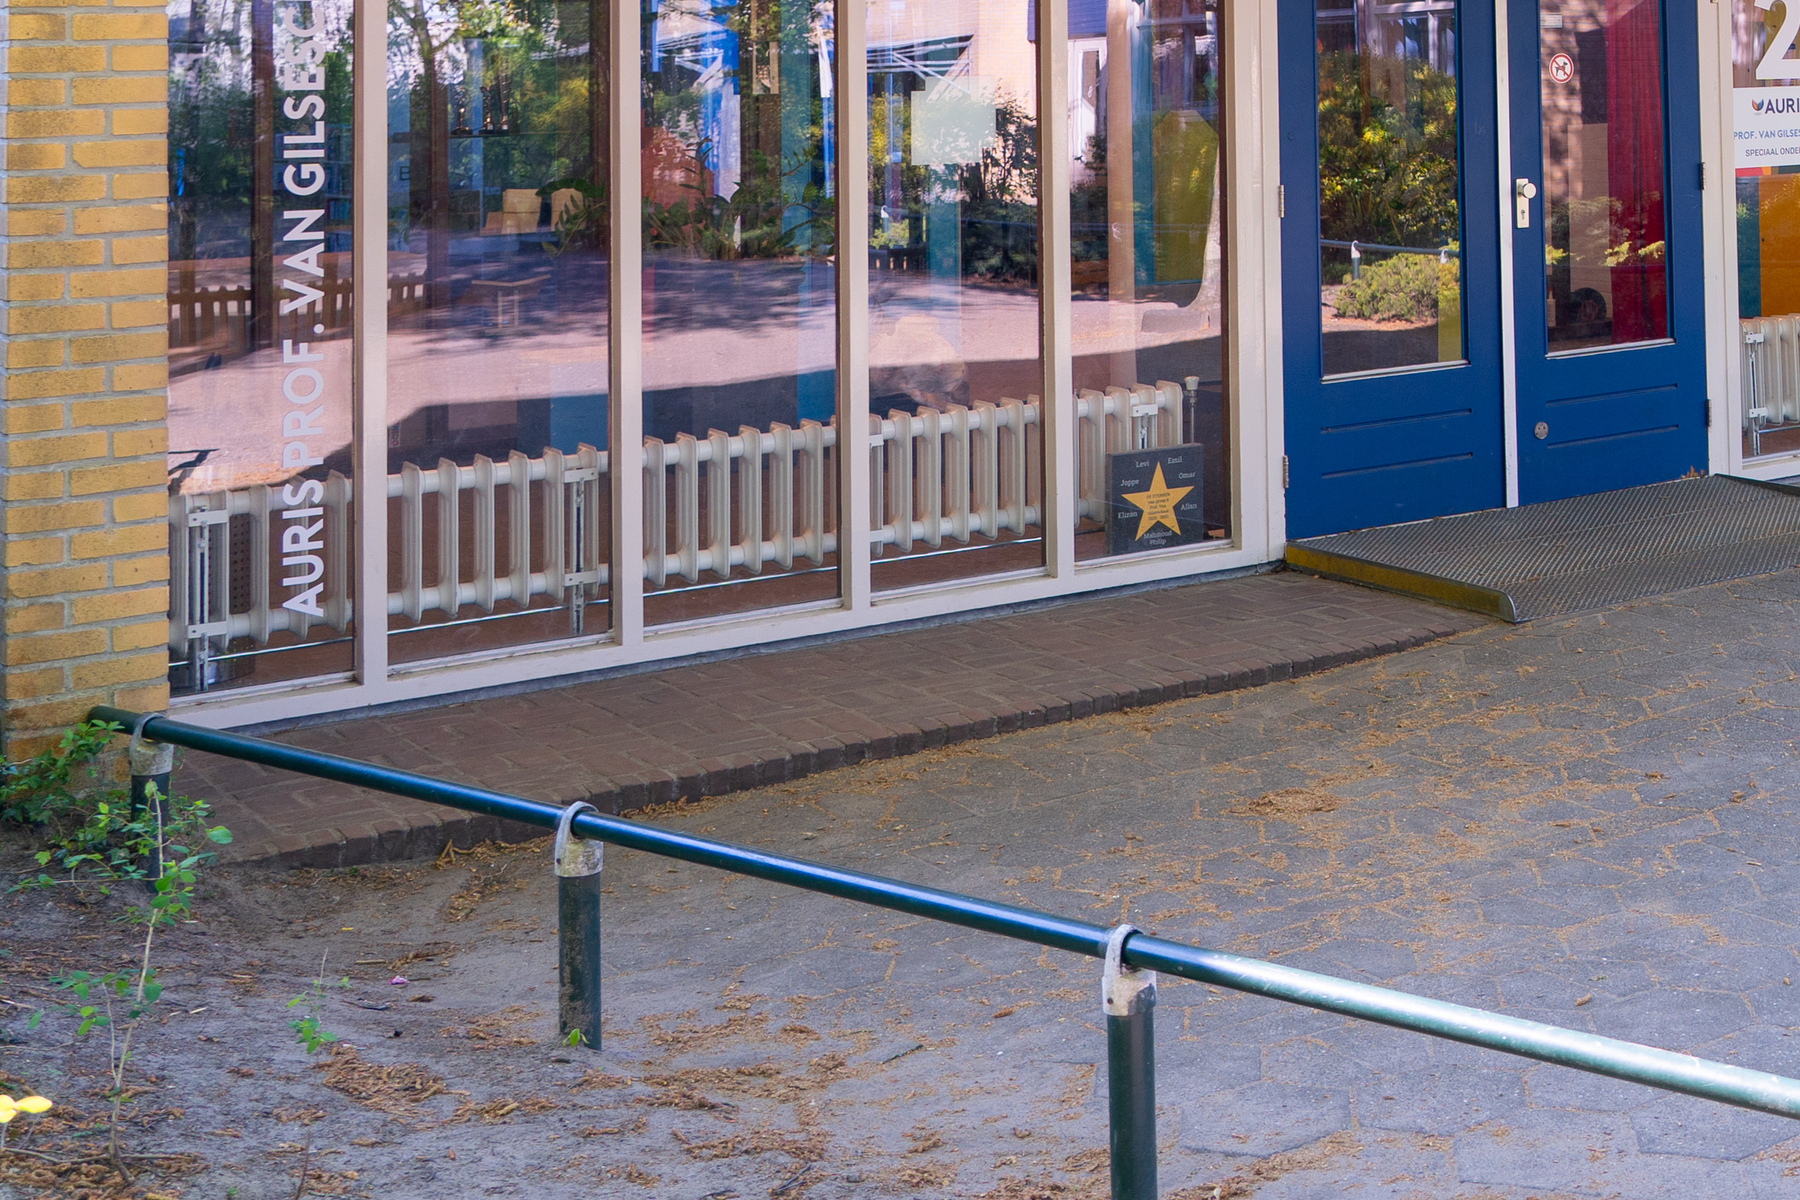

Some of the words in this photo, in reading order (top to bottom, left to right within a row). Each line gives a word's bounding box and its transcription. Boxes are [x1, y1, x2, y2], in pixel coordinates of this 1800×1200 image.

[1733, 130, 1758, 140] PROF.
[1758, 129, 1776, 139] VAN
[1745, 147, 1779, 157] SPECIAAL
[283, 208, 326, 315] VAN
[282, 323, 325, 469] PROF.
[1136, 460, 1150, 468] Levi
[1167, 456, 1183, 464] Emil
[1120, 479, 1140, 487] Joppe
[1181, 502, 1197, 510] Allan
[282, 479, 325, 617] AURIS
